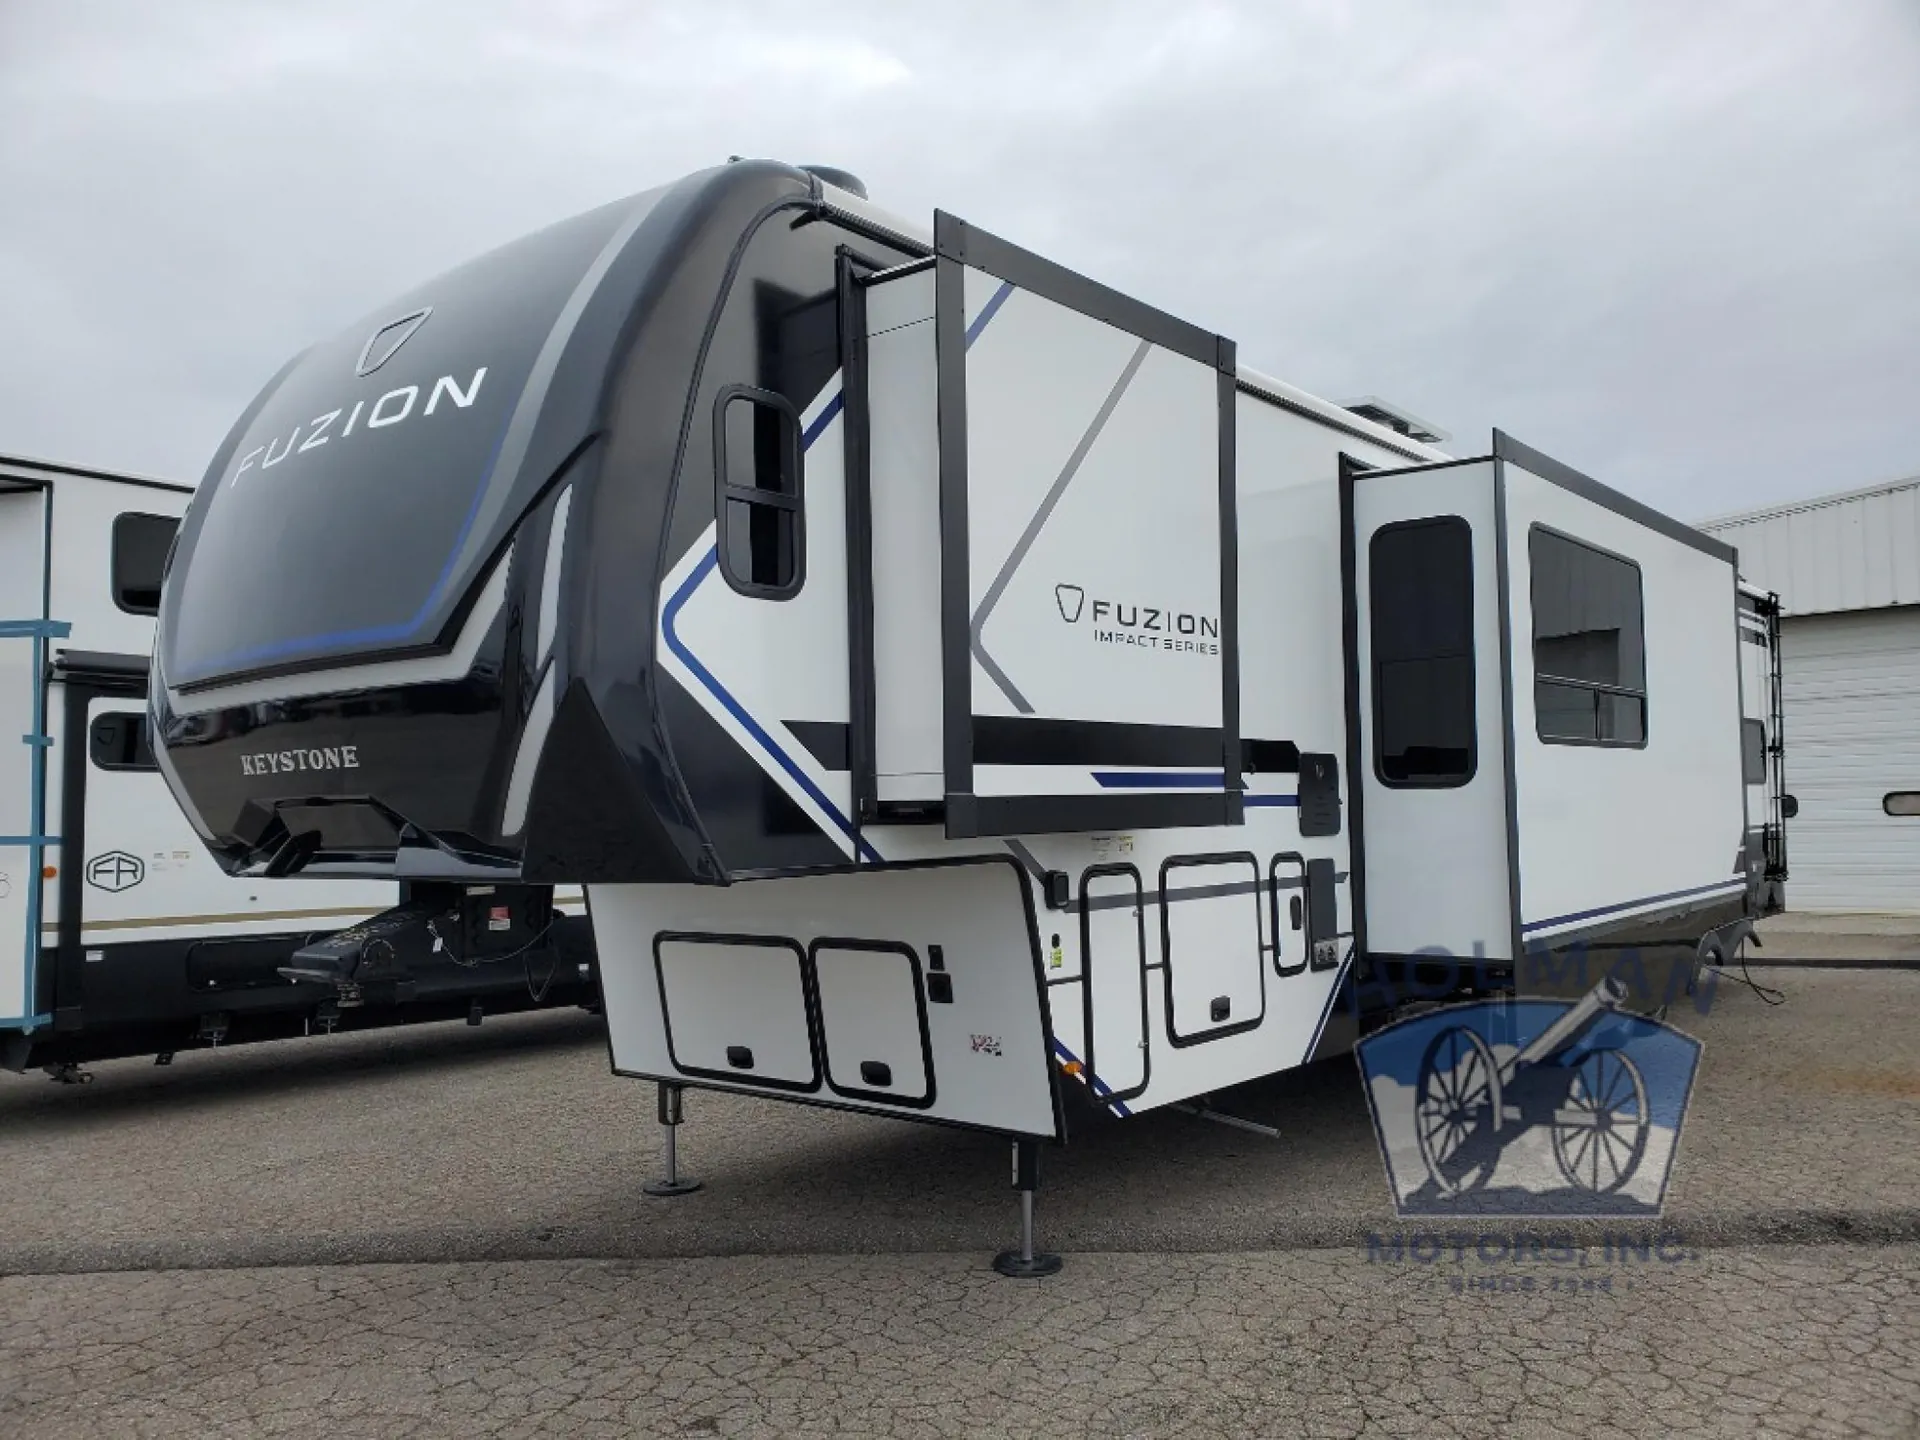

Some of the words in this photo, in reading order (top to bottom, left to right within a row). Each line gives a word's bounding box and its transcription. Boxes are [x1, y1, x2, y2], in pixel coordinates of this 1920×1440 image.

[231, 366, 488, 488] FUZION
[1092, 600, 1218, 637] FUZION
[1094, 629, 1159, 647] IMPACT
[1163, 638, 1219, 655] SERIES
[241, 745, 360, 776] KEYSTONE
